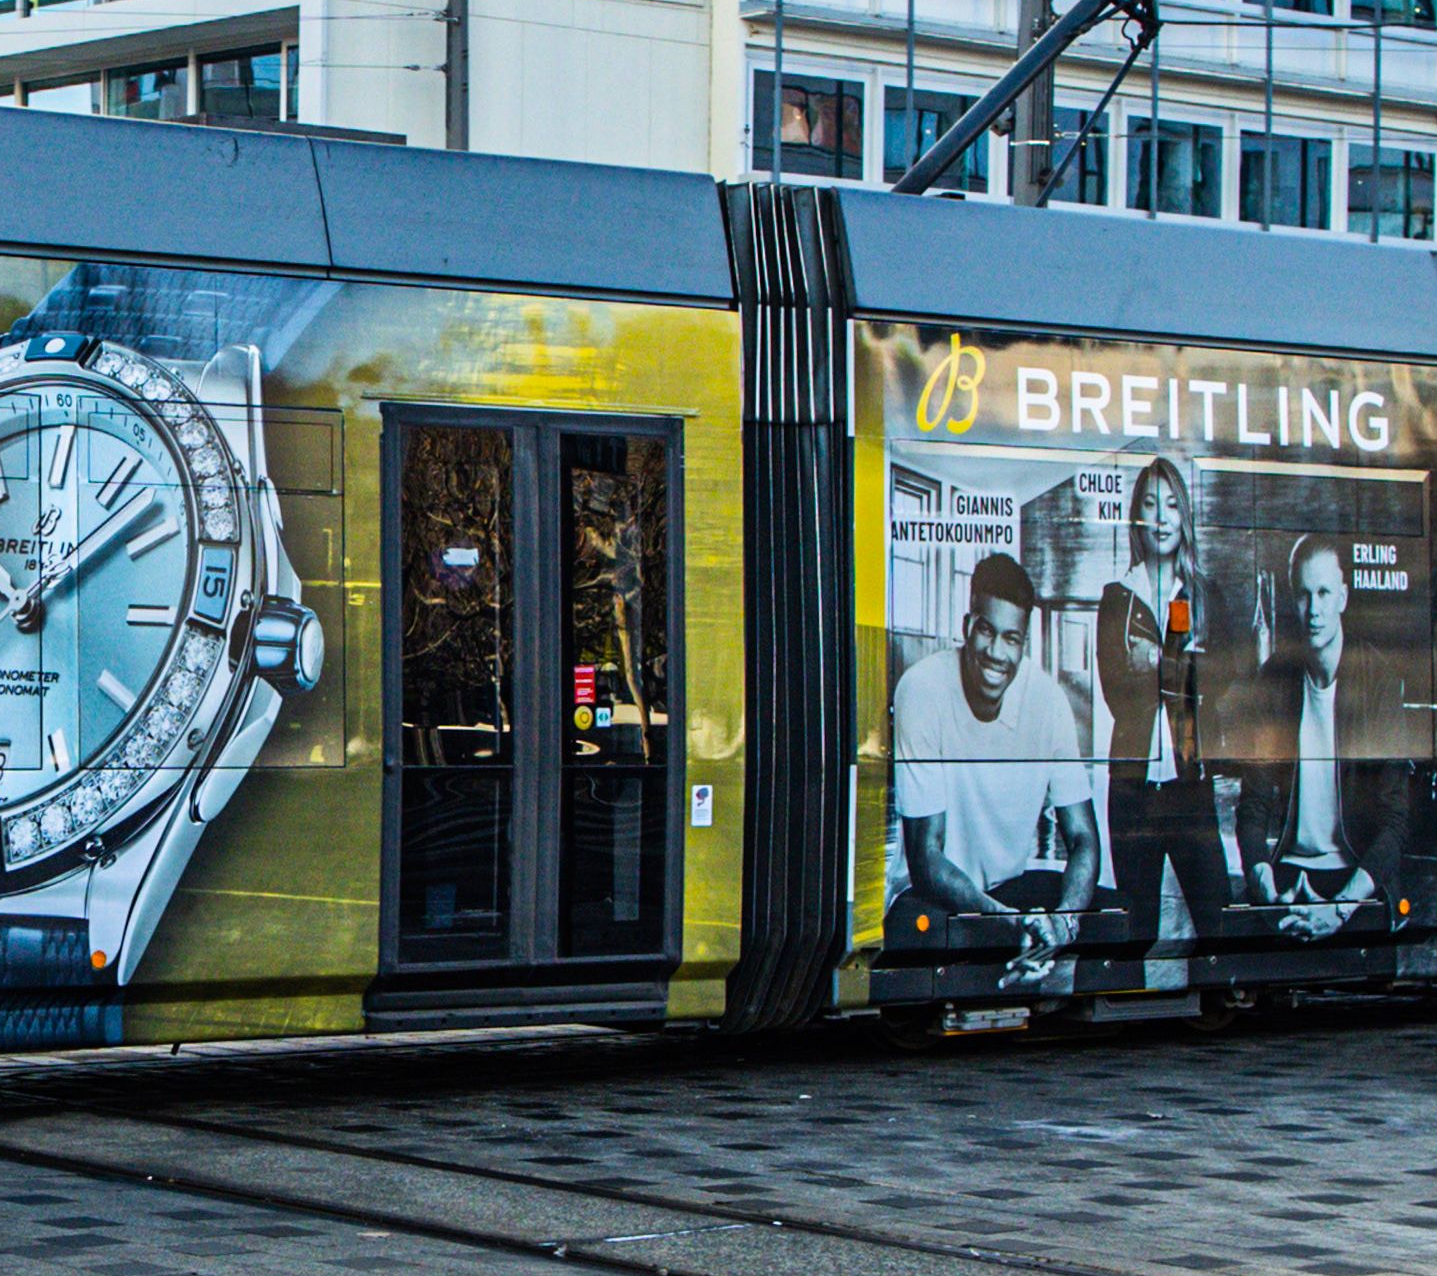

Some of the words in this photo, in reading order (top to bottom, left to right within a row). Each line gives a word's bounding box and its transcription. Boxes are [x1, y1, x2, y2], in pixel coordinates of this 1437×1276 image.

[57, 394, 72, 407] 60
[1016, 367, 1390, 452] BREITLING
[132, 425, 146, 442] 05
[1079, 473, 1122, 494] CHLOE
[956, 495, 1013, 516] GIANNIS
[1099, 501, 1122, 520] KIM
[892, 520, 1013, 544] ANTETOKOUNMPO
[1353, 544, 1397, 565] ERLING
[203, 565, 227, 598] 15
[1353, 570, 1408, 591] HAALAND
